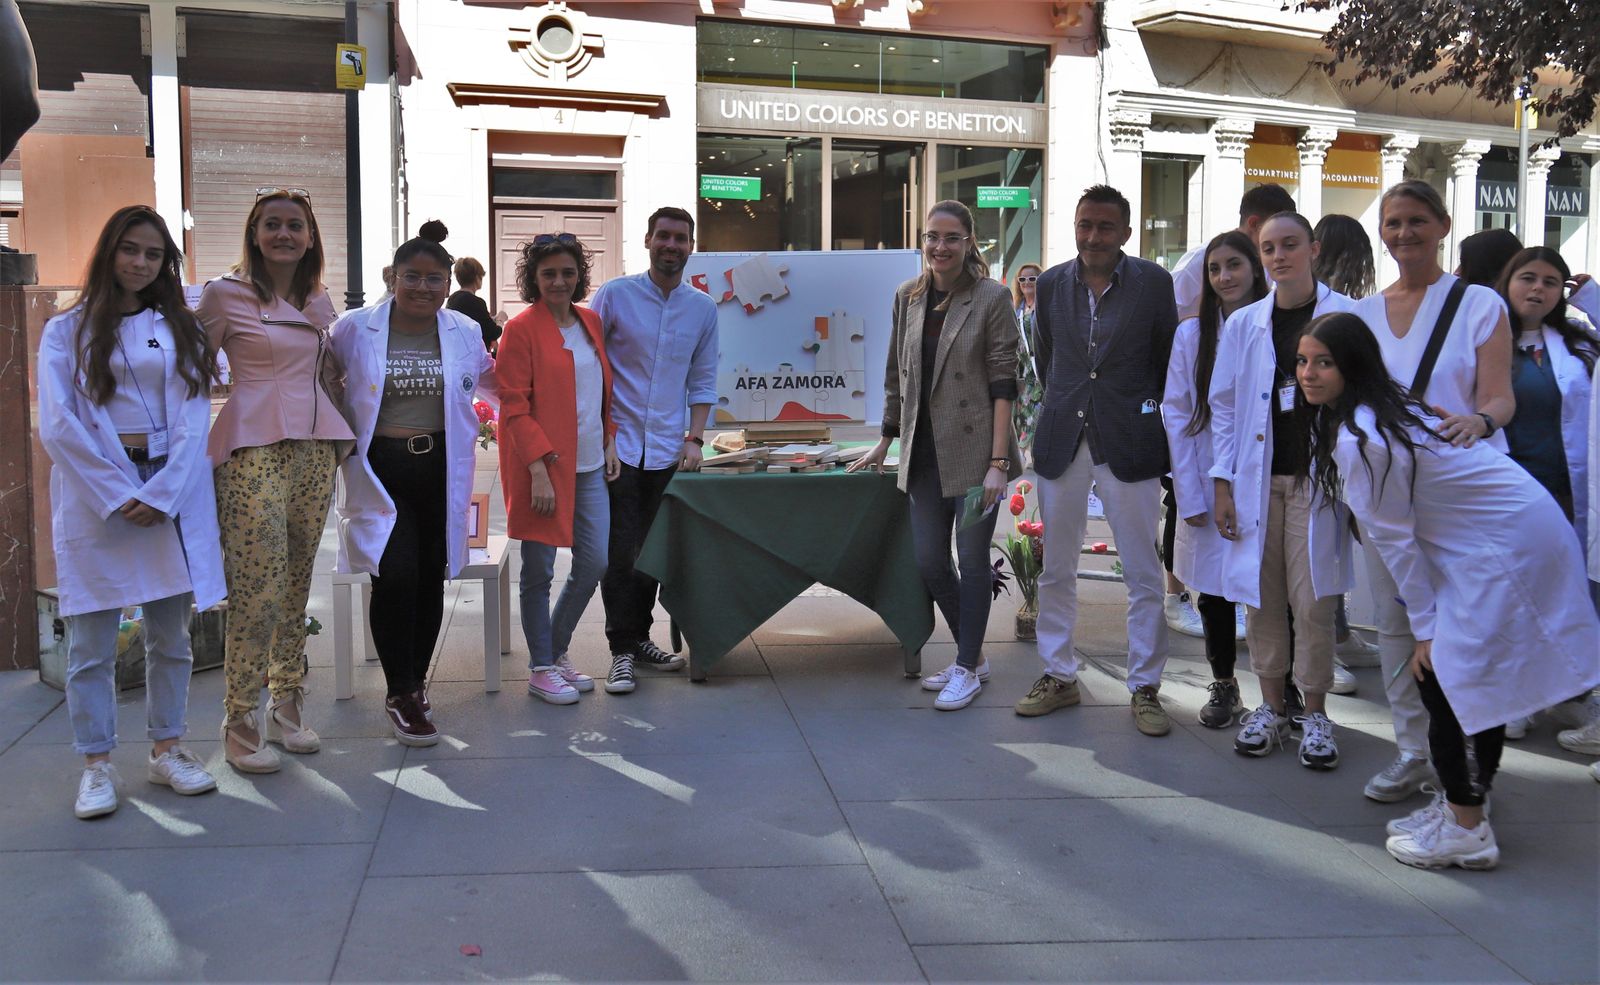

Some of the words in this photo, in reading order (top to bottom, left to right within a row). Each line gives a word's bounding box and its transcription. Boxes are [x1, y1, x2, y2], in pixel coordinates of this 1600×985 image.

[554, 109, 564, 124] 4
[720, 99, 800, 121] UNITED
[805, 104, 888, 127] COLORS
[892, 109, 920, 128] OF
[1243, 168, 1299, 179] ACOMARTINEZ
[1321, 174, 1379, 184] PACOMARTINEZ
[1480, 185, 1516, 208] NAN
[1548, 190, 1582, 212] NAN
[735, 376, 767, 389] AFA
[772, 375, 845, 389] ZAMORA
